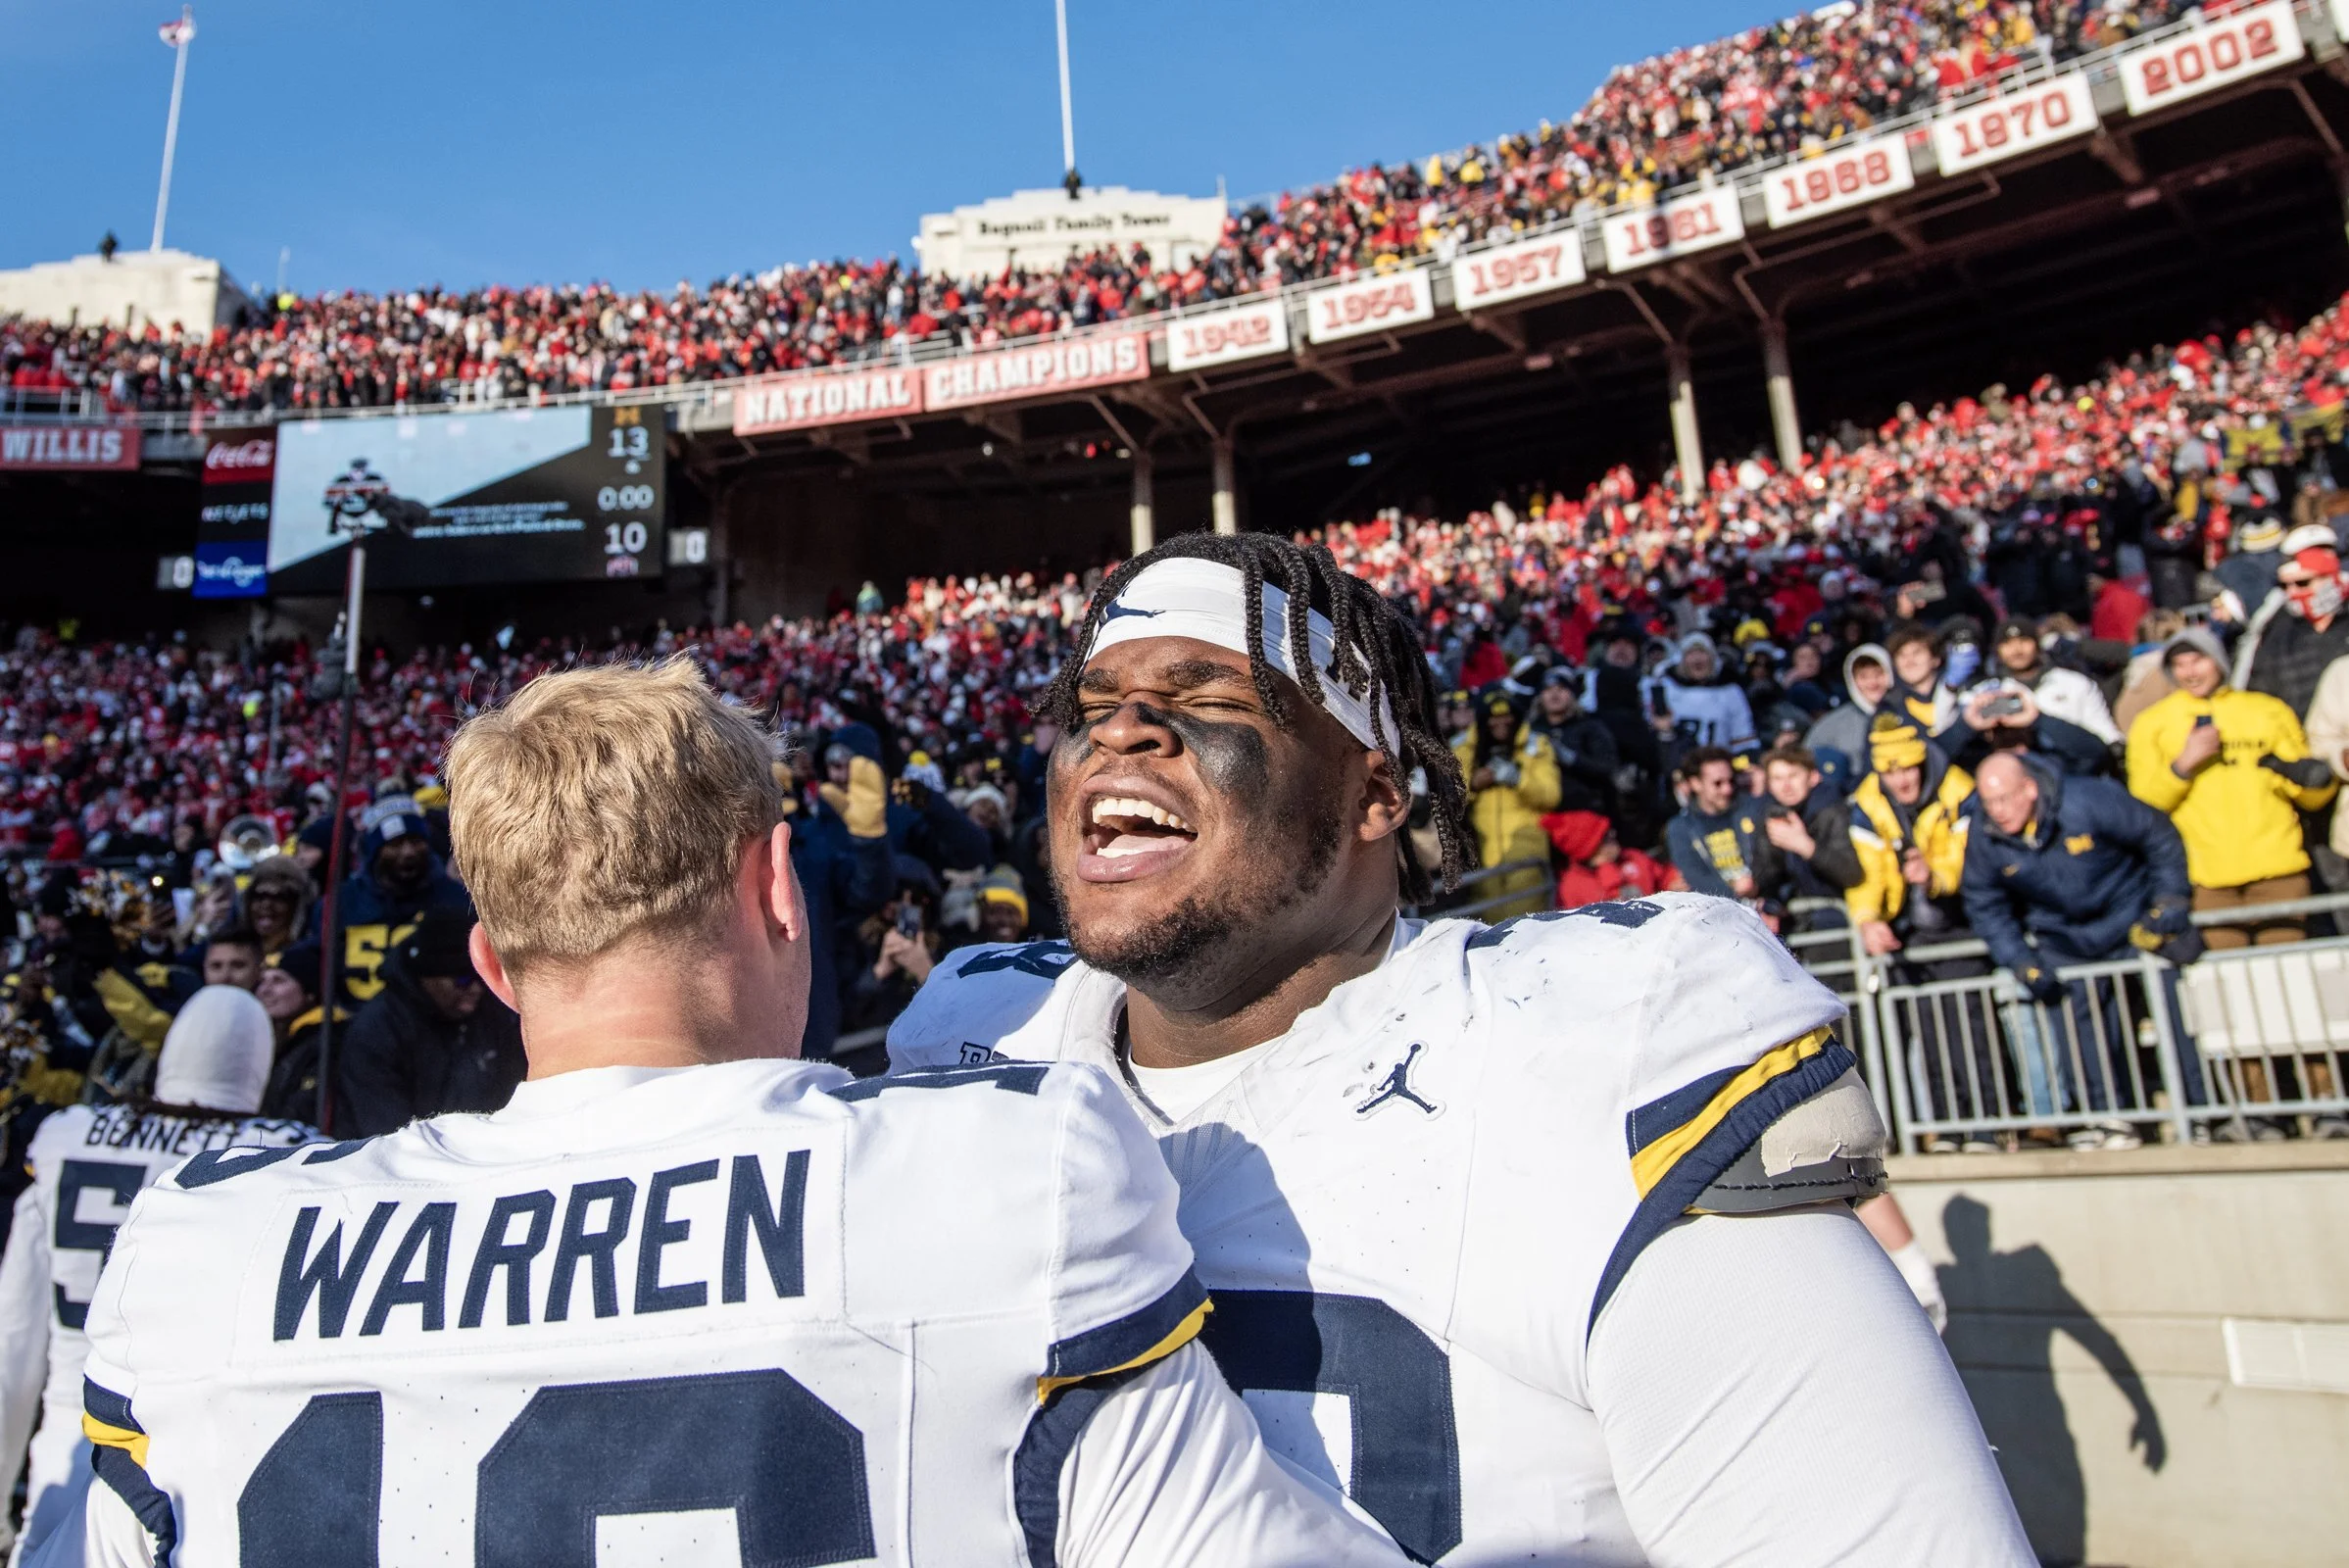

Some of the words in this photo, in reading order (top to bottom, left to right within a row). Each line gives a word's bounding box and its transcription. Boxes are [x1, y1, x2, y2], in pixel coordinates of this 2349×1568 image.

[2142, 18, 2277, 95] 2002
[1955, 91, 2071, 156] 1970
[1782, 151, 1890, 212] 1968
[1470, 246, 1562, 295] 1957
[1324, 282, 1417, 328] 1954
[1182, 316, 1271, 358] 1942
[745, 373, 911, 424] NATIONAL
[928, 336, 1139, 400] CHAMPIONS
[3, 430, 122, 463] WILLIS
[608, 425, 650, 458] 13
[604, 521, 648, 555] 10
[345, 923, 417, 1001] 5
[273, 1150, 810, 1343] WARREN
